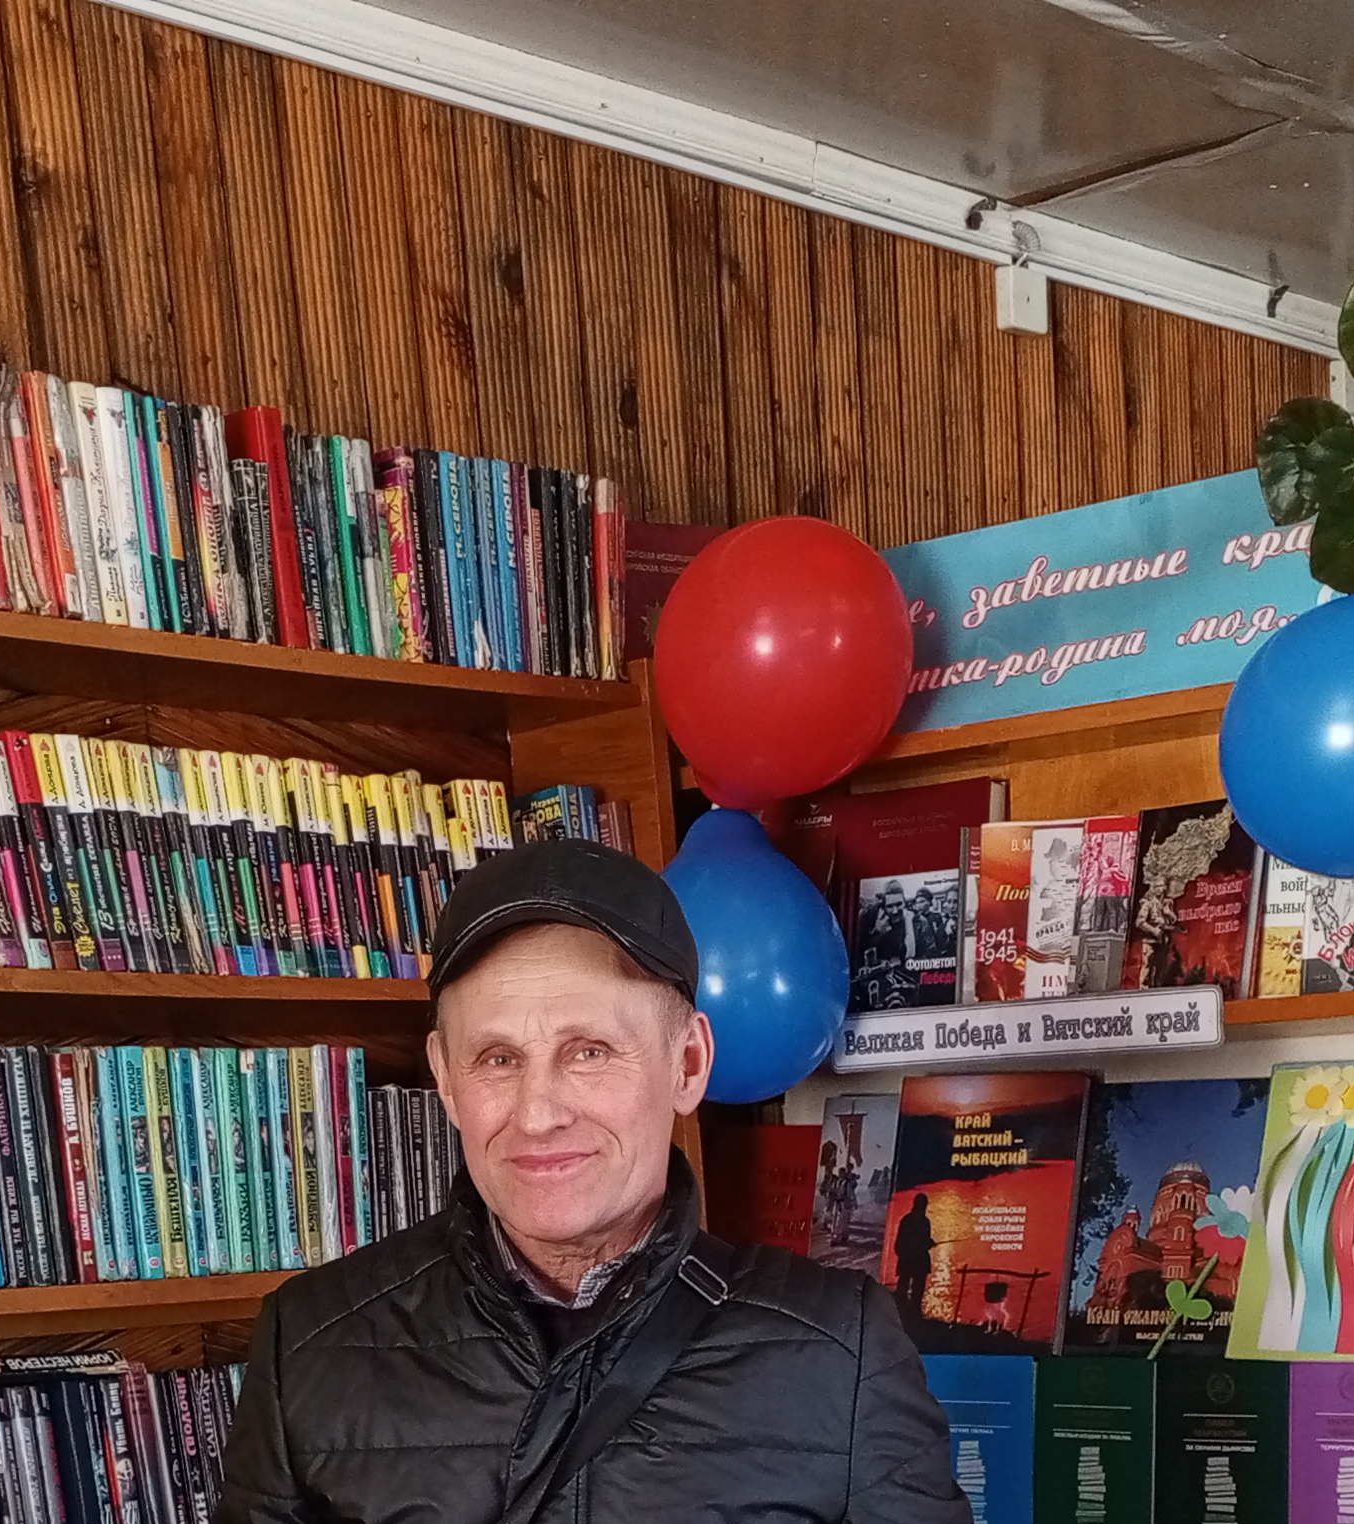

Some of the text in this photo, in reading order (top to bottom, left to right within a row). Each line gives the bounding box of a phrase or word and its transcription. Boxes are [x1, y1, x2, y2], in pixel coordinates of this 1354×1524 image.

[962, 546, 1189, 628] заветные
[1222, 521, 1313, 572] кра
[908, 629, 1147, 695] тка-родина
[1195, 879, 1243, 899] Время
[1178, 902, 1242, 922] выбрало
[1214, 919, 1240, 935] нас
[979, 929, 1016, 947] 1941
[978, 946, 1018, 965] 1945
[843, 1001, 1201, 1057] Великая Победа и Вятский край
[61, 1077, 79, 1144] А. БУШКОВ
[955, 1112, 991, 1129] КРАЙ
[951, 1148, 1028, 1167] РЫБАЦКИЙ
